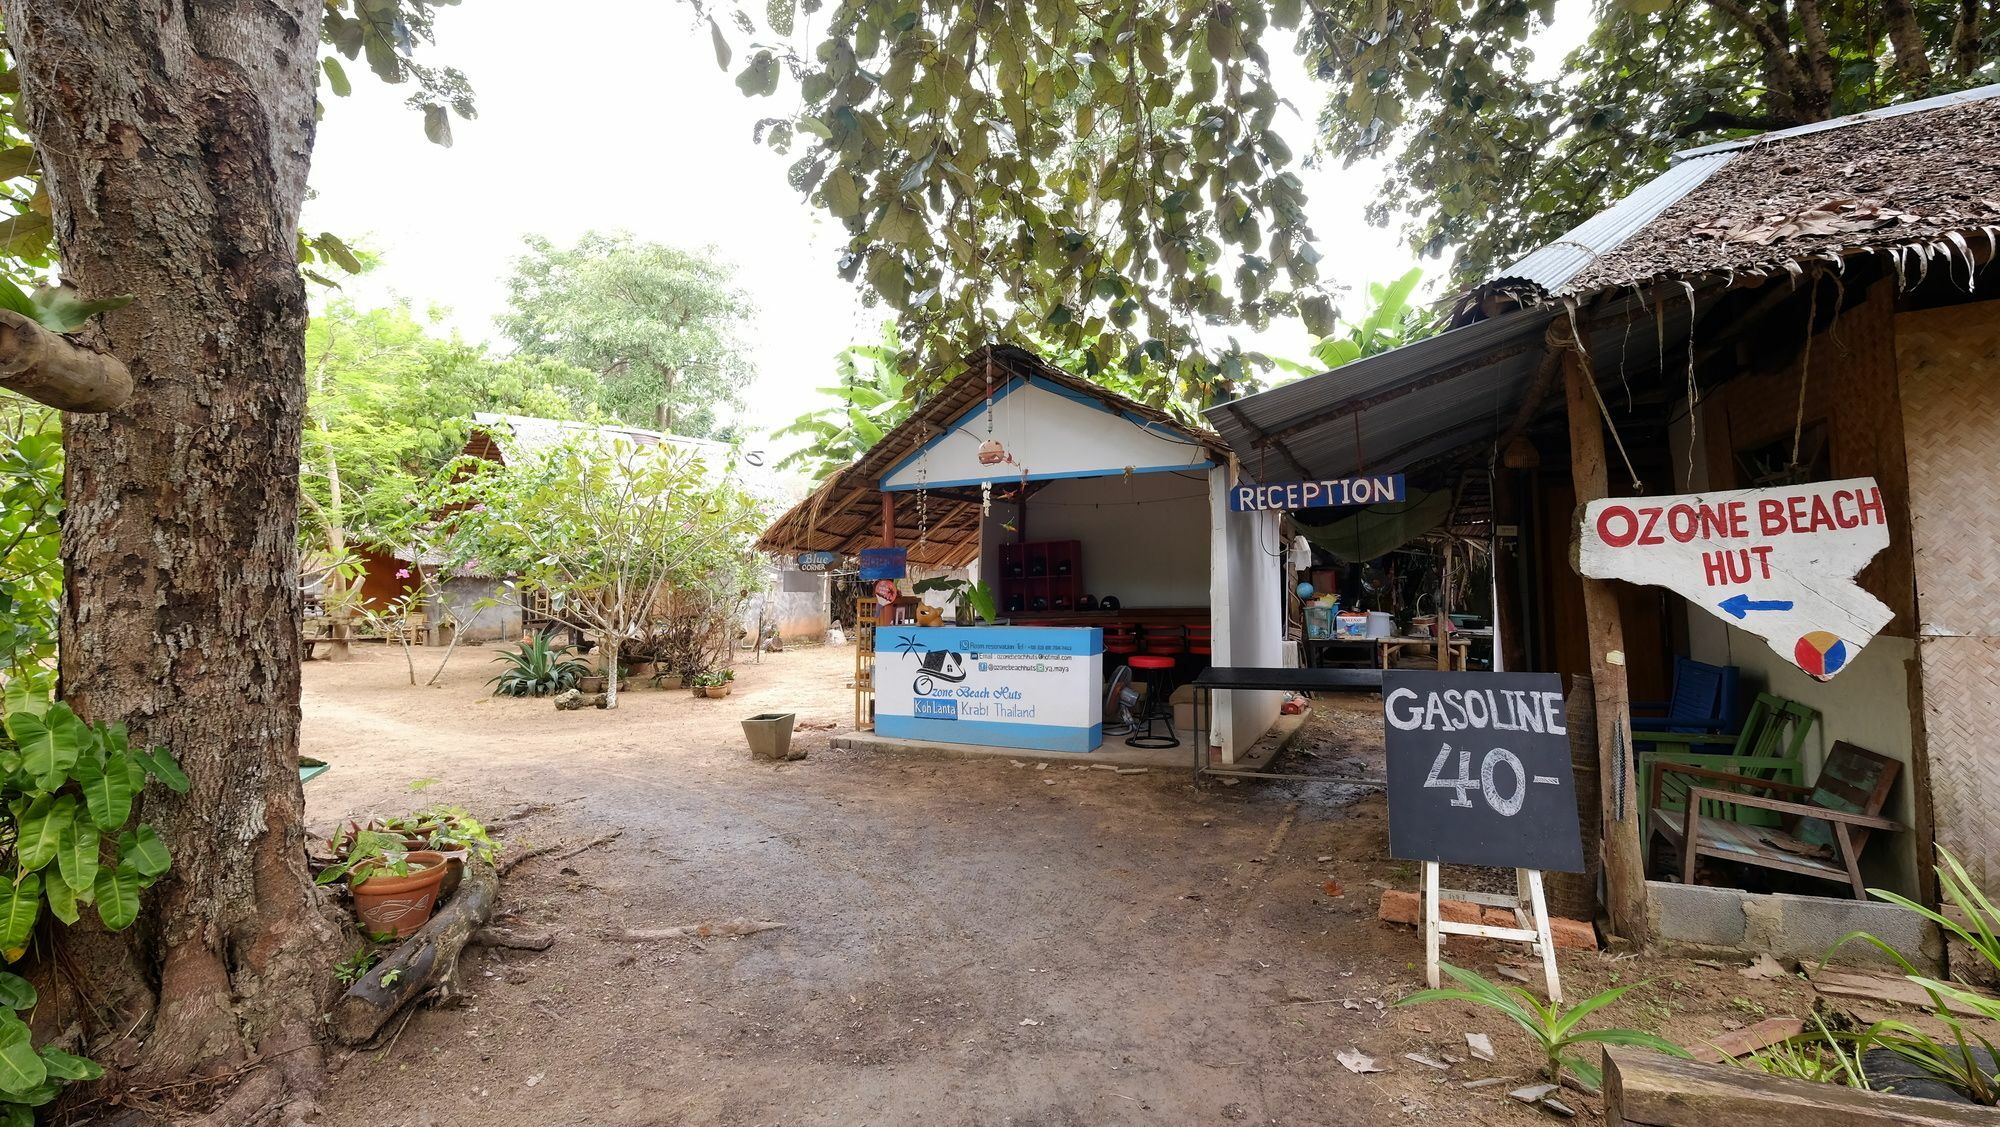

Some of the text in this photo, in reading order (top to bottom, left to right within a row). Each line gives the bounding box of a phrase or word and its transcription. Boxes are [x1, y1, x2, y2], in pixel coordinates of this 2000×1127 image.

[1239, 476, 1395, 511] RECEPTION
[1597, 486, 1885, 547] OZONE BEACH
[803, 553, 829, 564] Blue
[1702, 546, 1773, 586] HUT
[913, 675, 1022, 700] Ozone Beach Huts
[915, 700, 1035, 718] Koh Lanta Krabi Thailand
[1385, 687, 1566, 735] GASOLINE
